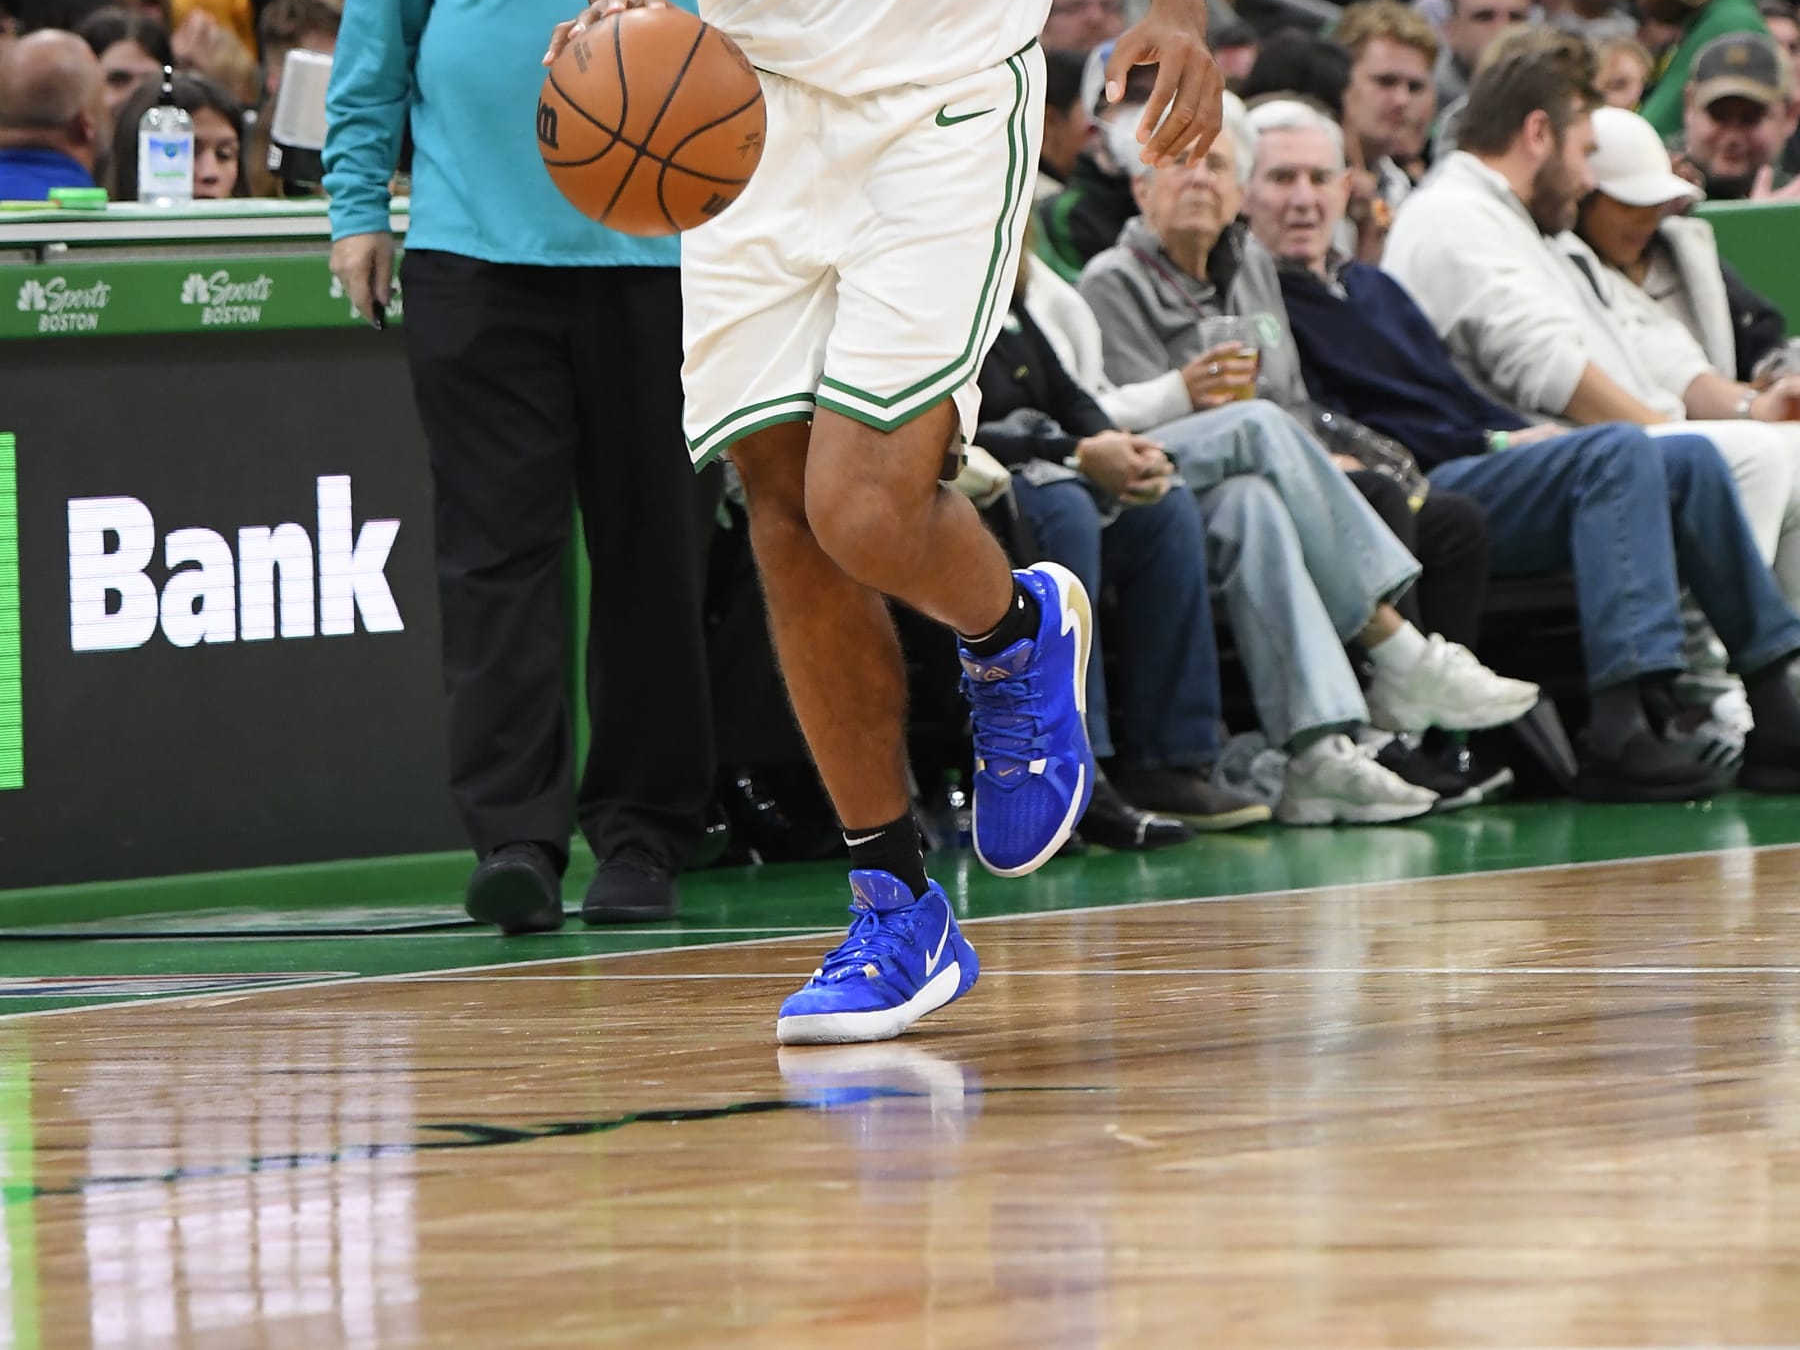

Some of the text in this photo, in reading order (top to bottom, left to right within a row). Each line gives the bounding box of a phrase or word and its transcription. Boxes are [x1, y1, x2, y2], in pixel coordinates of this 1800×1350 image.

[45, 276, 112, 314] Sports
[208, 269, 274, 307] Sports
[38, 312, 99, 333] BOSTON
[202, 306, 262, 325] BOSTON
[67, 474, 405, 653] Bank
